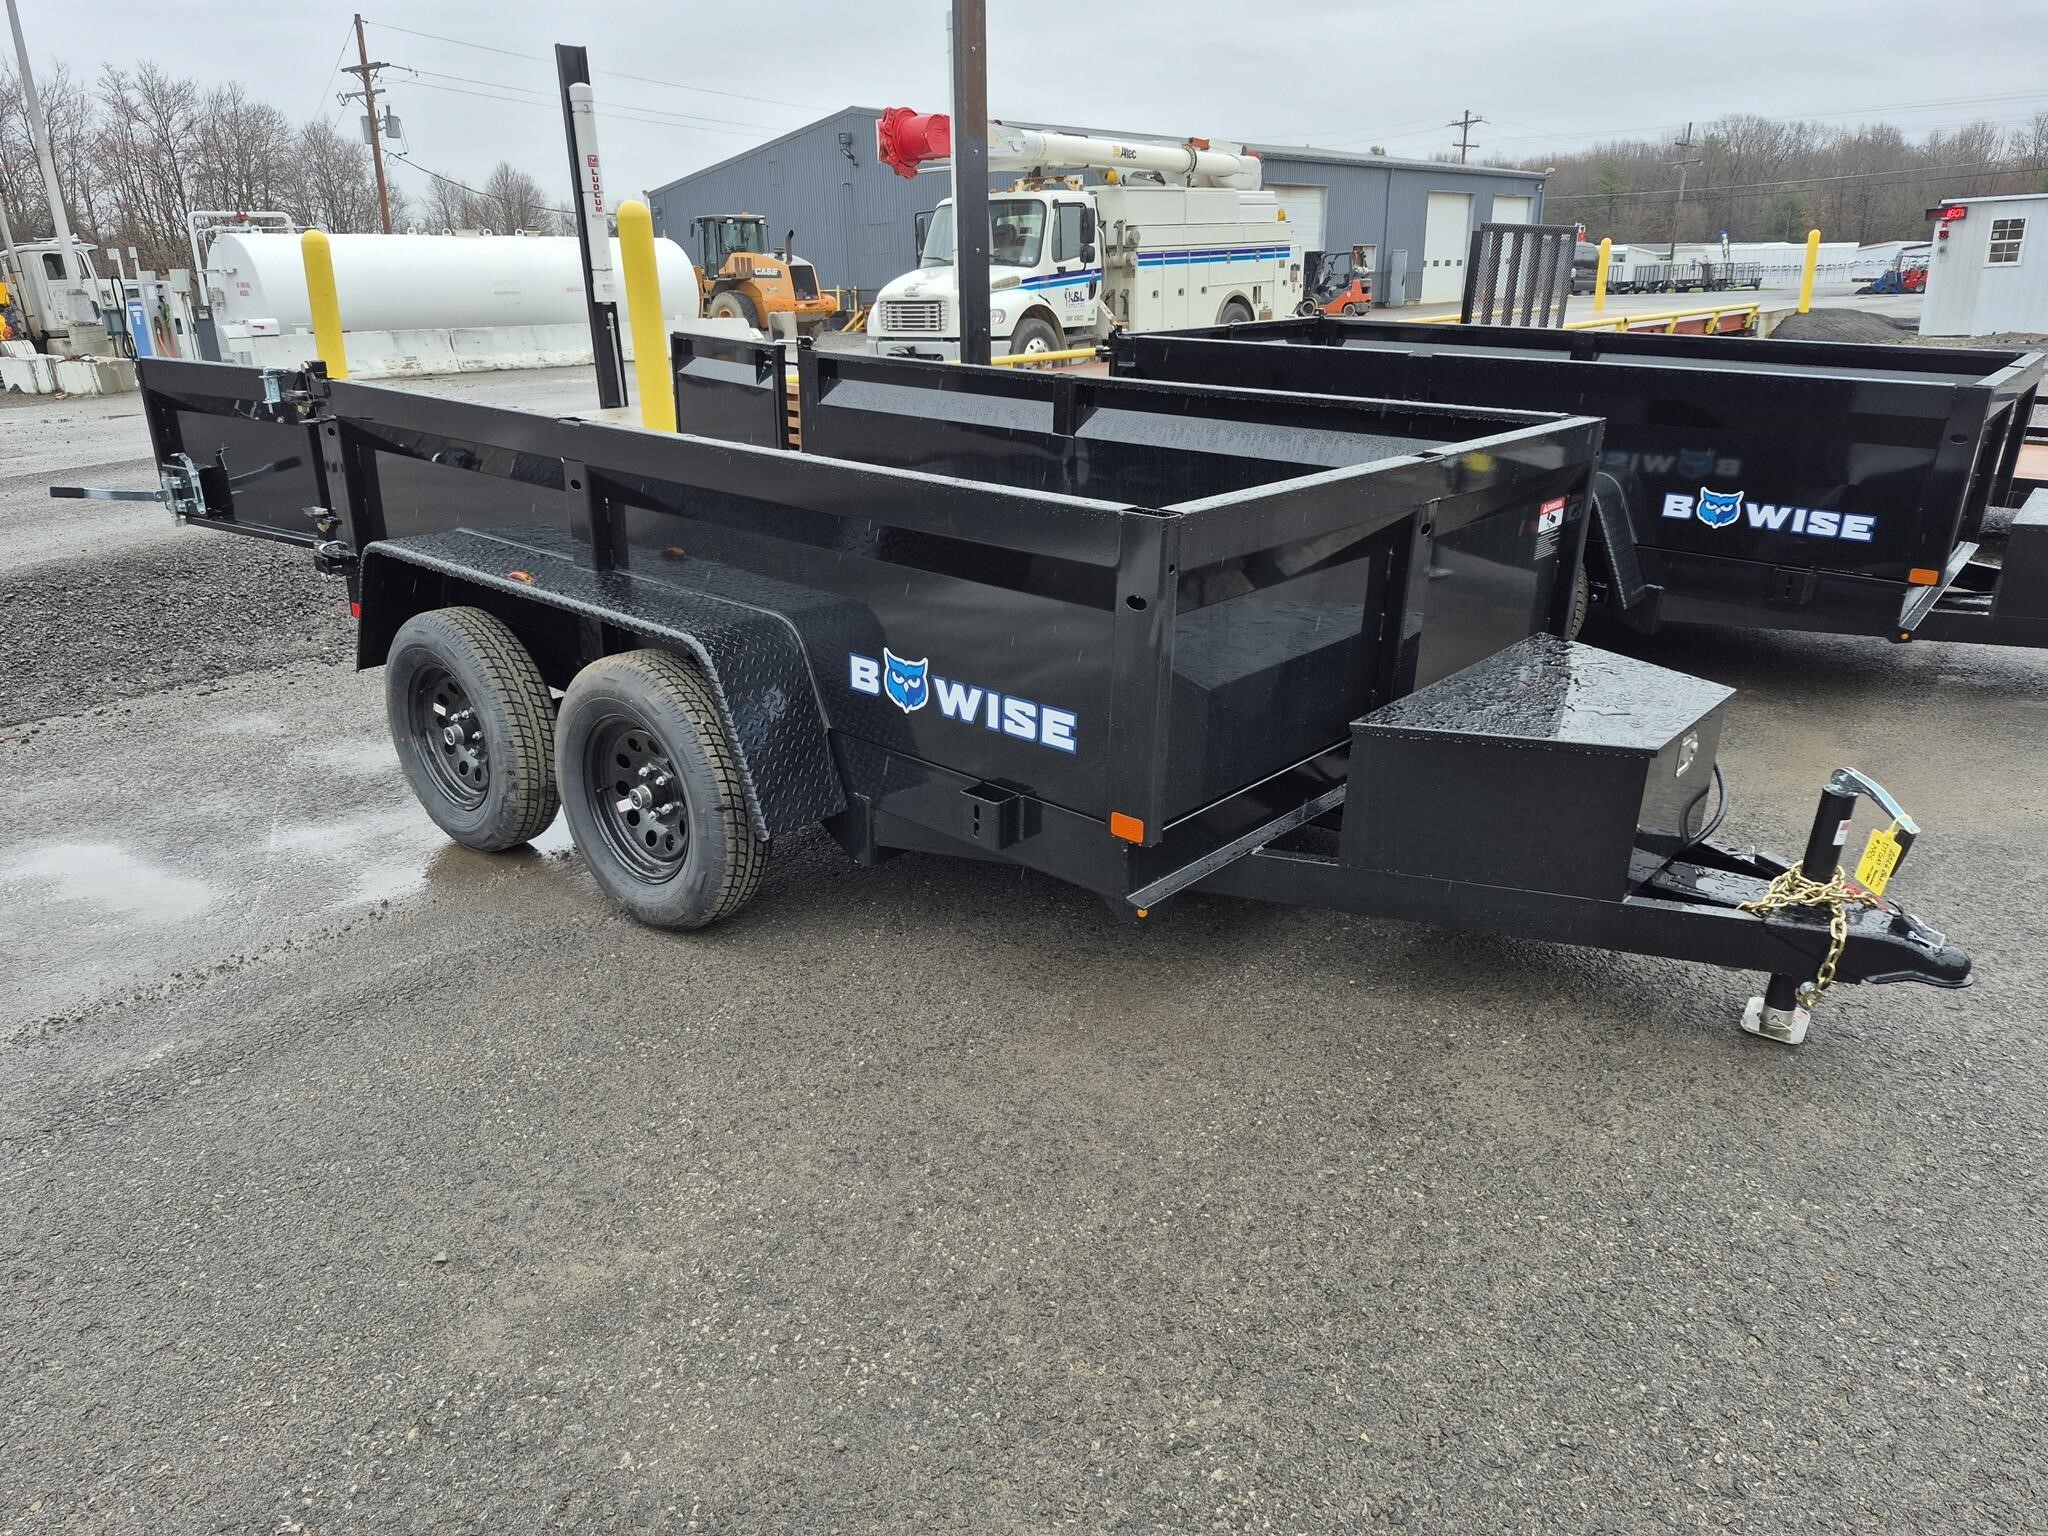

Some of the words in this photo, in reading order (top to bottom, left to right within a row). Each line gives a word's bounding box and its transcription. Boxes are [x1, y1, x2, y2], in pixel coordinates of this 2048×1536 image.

[591, 168, 603, 213] LUDLUM
[754, 267, 778, 276] CASE
[1068, 291, 1085, 303] K&L
